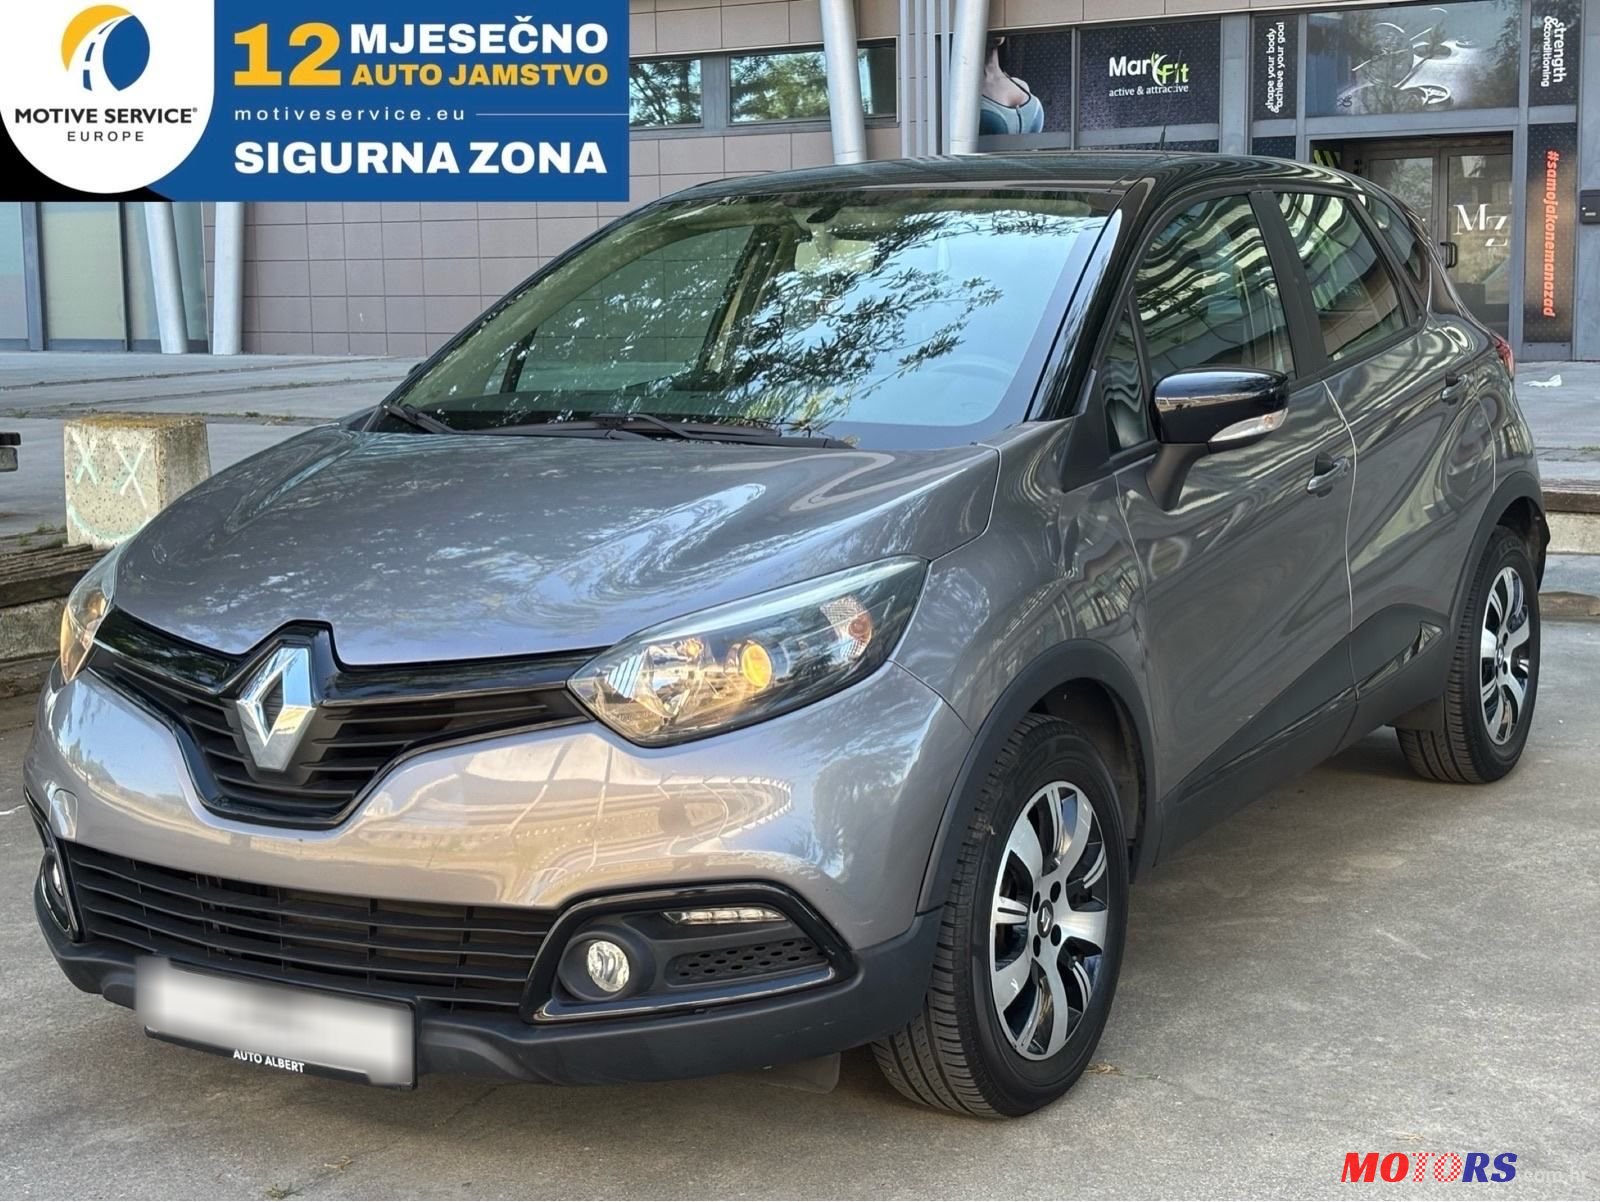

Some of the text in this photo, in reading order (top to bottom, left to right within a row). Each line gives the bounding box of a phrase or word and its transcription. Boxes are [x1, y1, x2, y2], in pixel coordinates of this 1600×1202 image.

[1276, 21, 1286, 43] goal
[1264, 28, 1277, 109] shape your body
[1277, 46, 1286, 69] your
[1540, 27, 1553, 88] conditioning
[1551, 22, 1567, 83] strength
[1108, 86, 1135, 97] active
[1136, 85, 1145, 96] &
[1274, 70, 1284, 108] achieve
[1543, 150, 1560, 318] #samojakonemanazad
[233, 1049, 305, 1073] AUTO ALBERT
